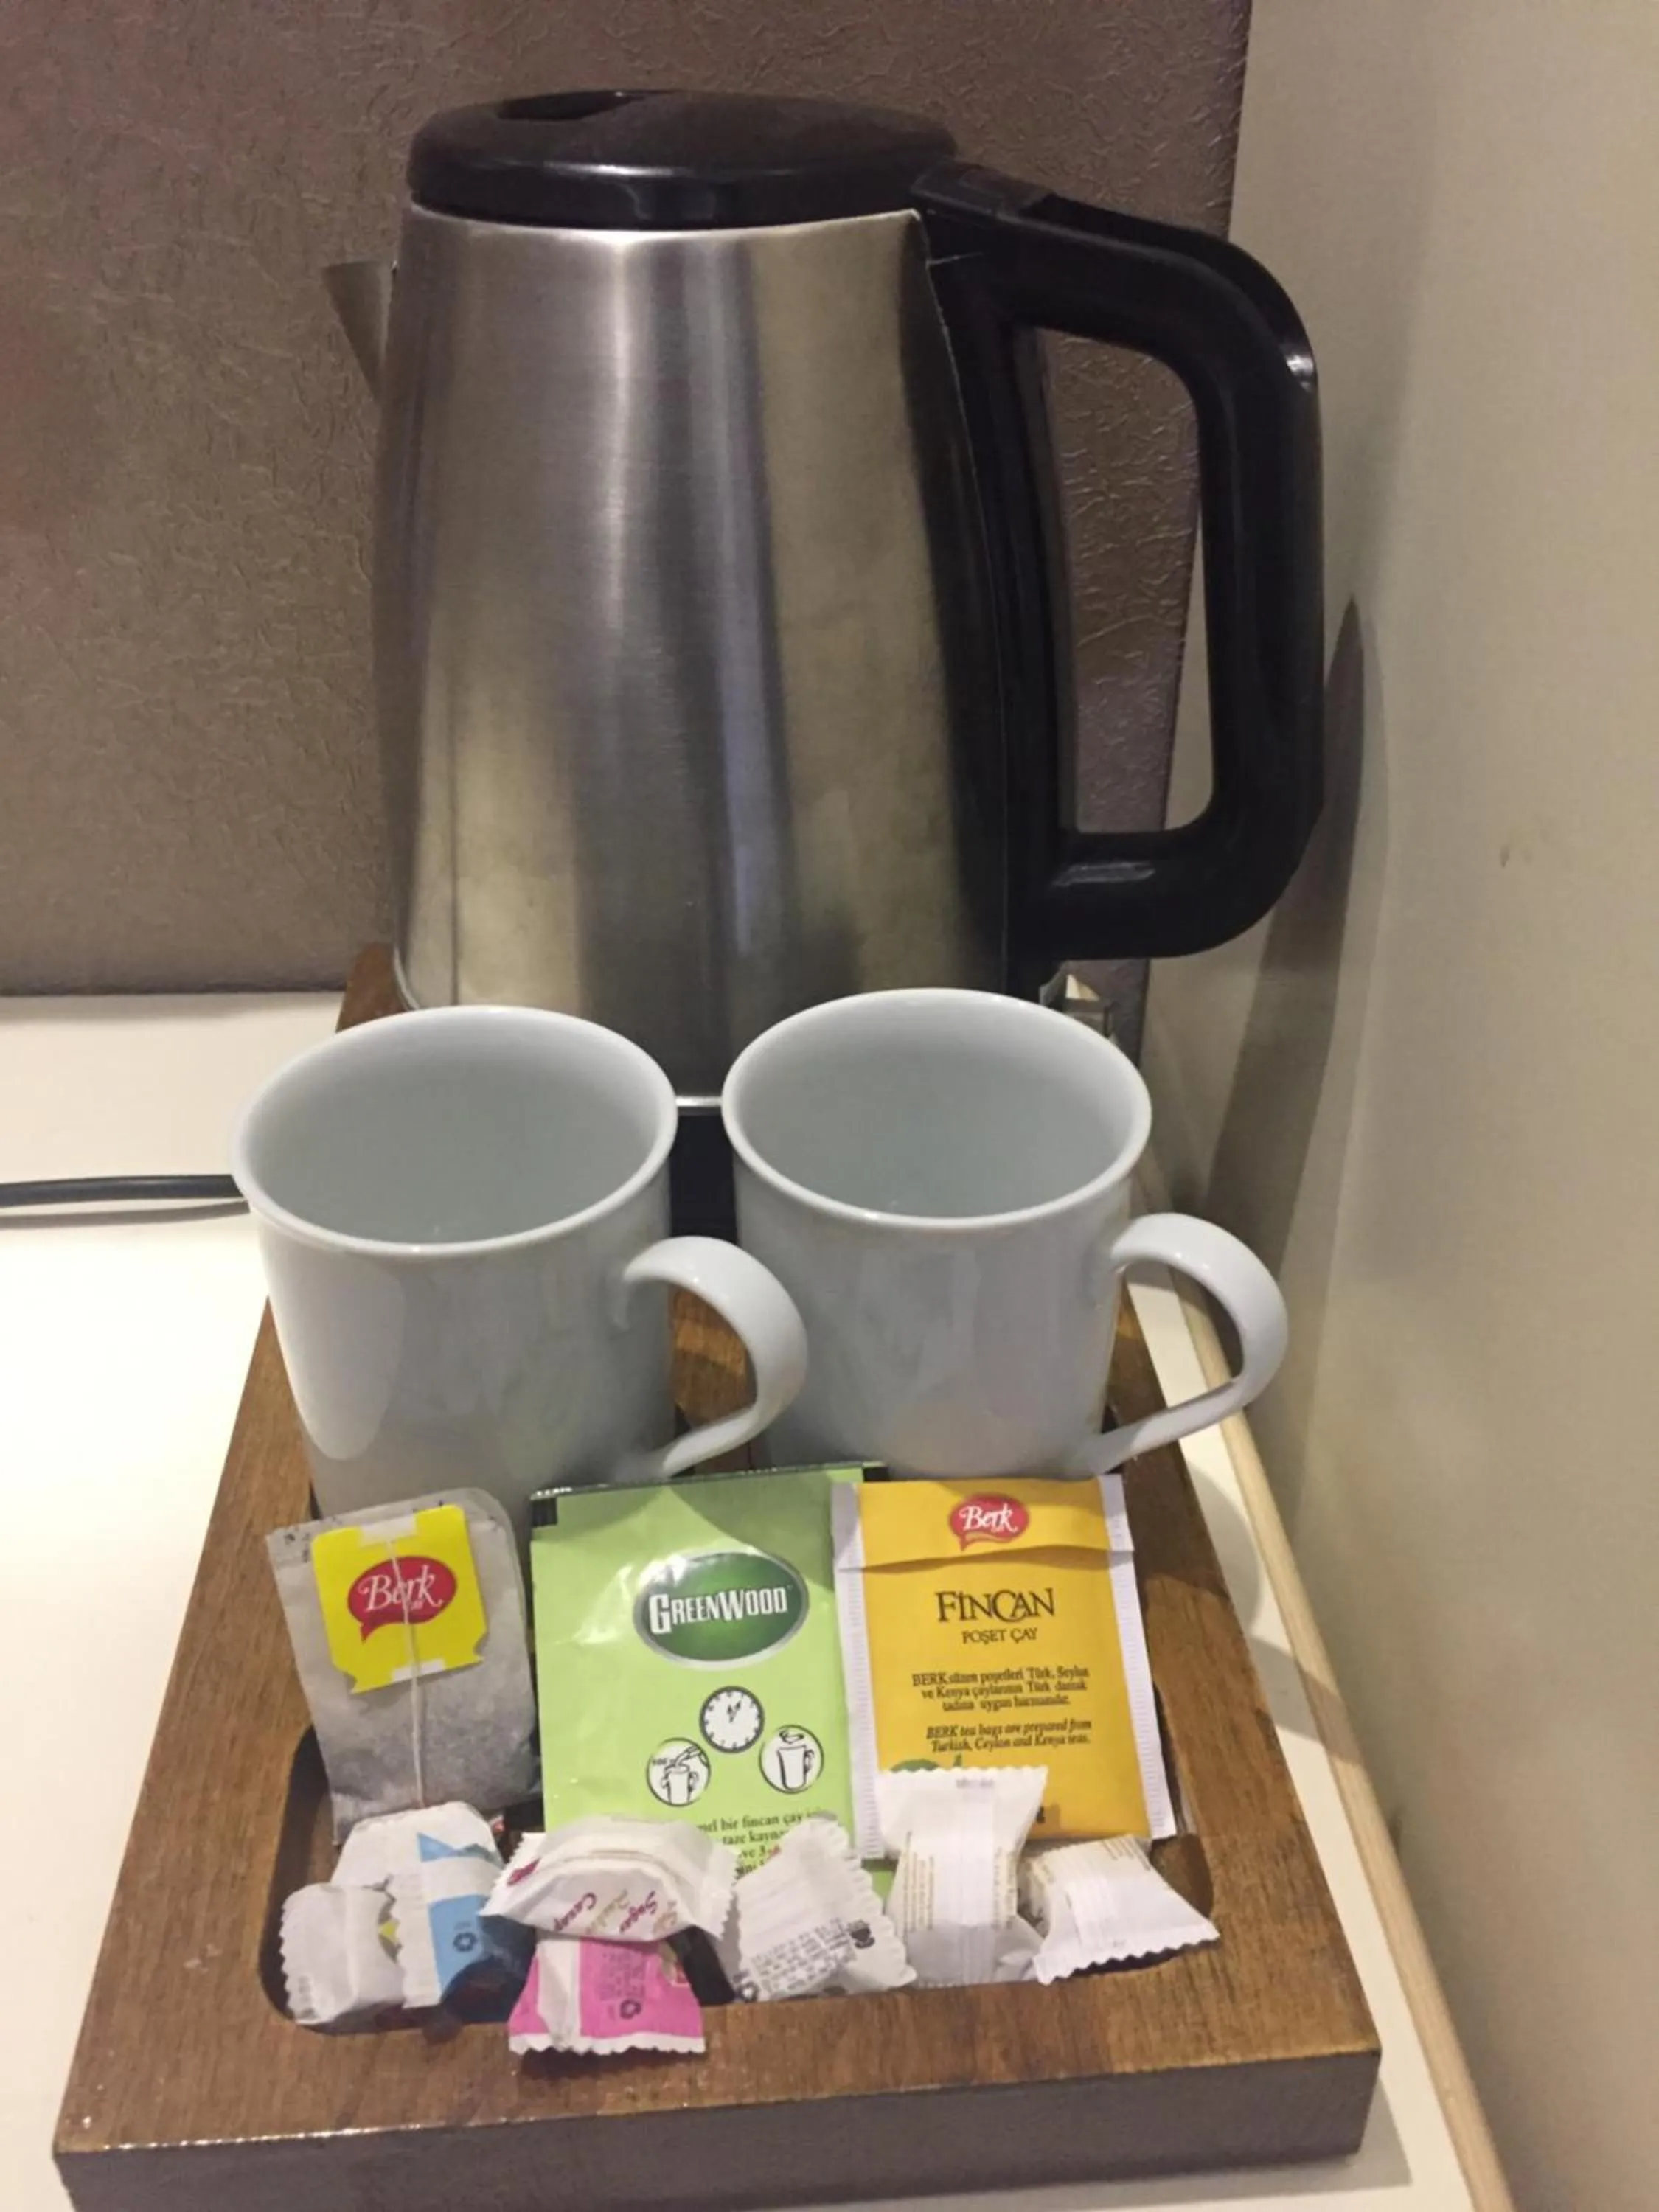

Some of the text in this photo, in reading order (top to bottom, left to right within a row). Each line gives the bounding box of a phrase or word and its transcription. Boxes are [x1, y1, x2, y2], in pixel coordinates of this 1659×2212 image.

[959, 1503, 1018, 1533] Berk
[358, 1564, 444, 1613] Berk
[1009, 1627, 1038, 1644] ÇAY
[912, 1672, 947, 1687] BERK
[936, 1686, 970, 1700] Kenya
[927, 1725, 958, 1739] BERK
[978, 1723, 1002, 1740] bags
[1004, 1723, 1021, 1734] are
[1022, 1717, 1068, 1736] prepared
[1068, 1717, 1091, 1733] from
[975, 1735, 1011, 1753] Ceylon
[1012, 1734, 1032, 1747] and
[1034, 1734, 1065, 1748] Kenya
[742, 1815, 779, 1828] fincan
